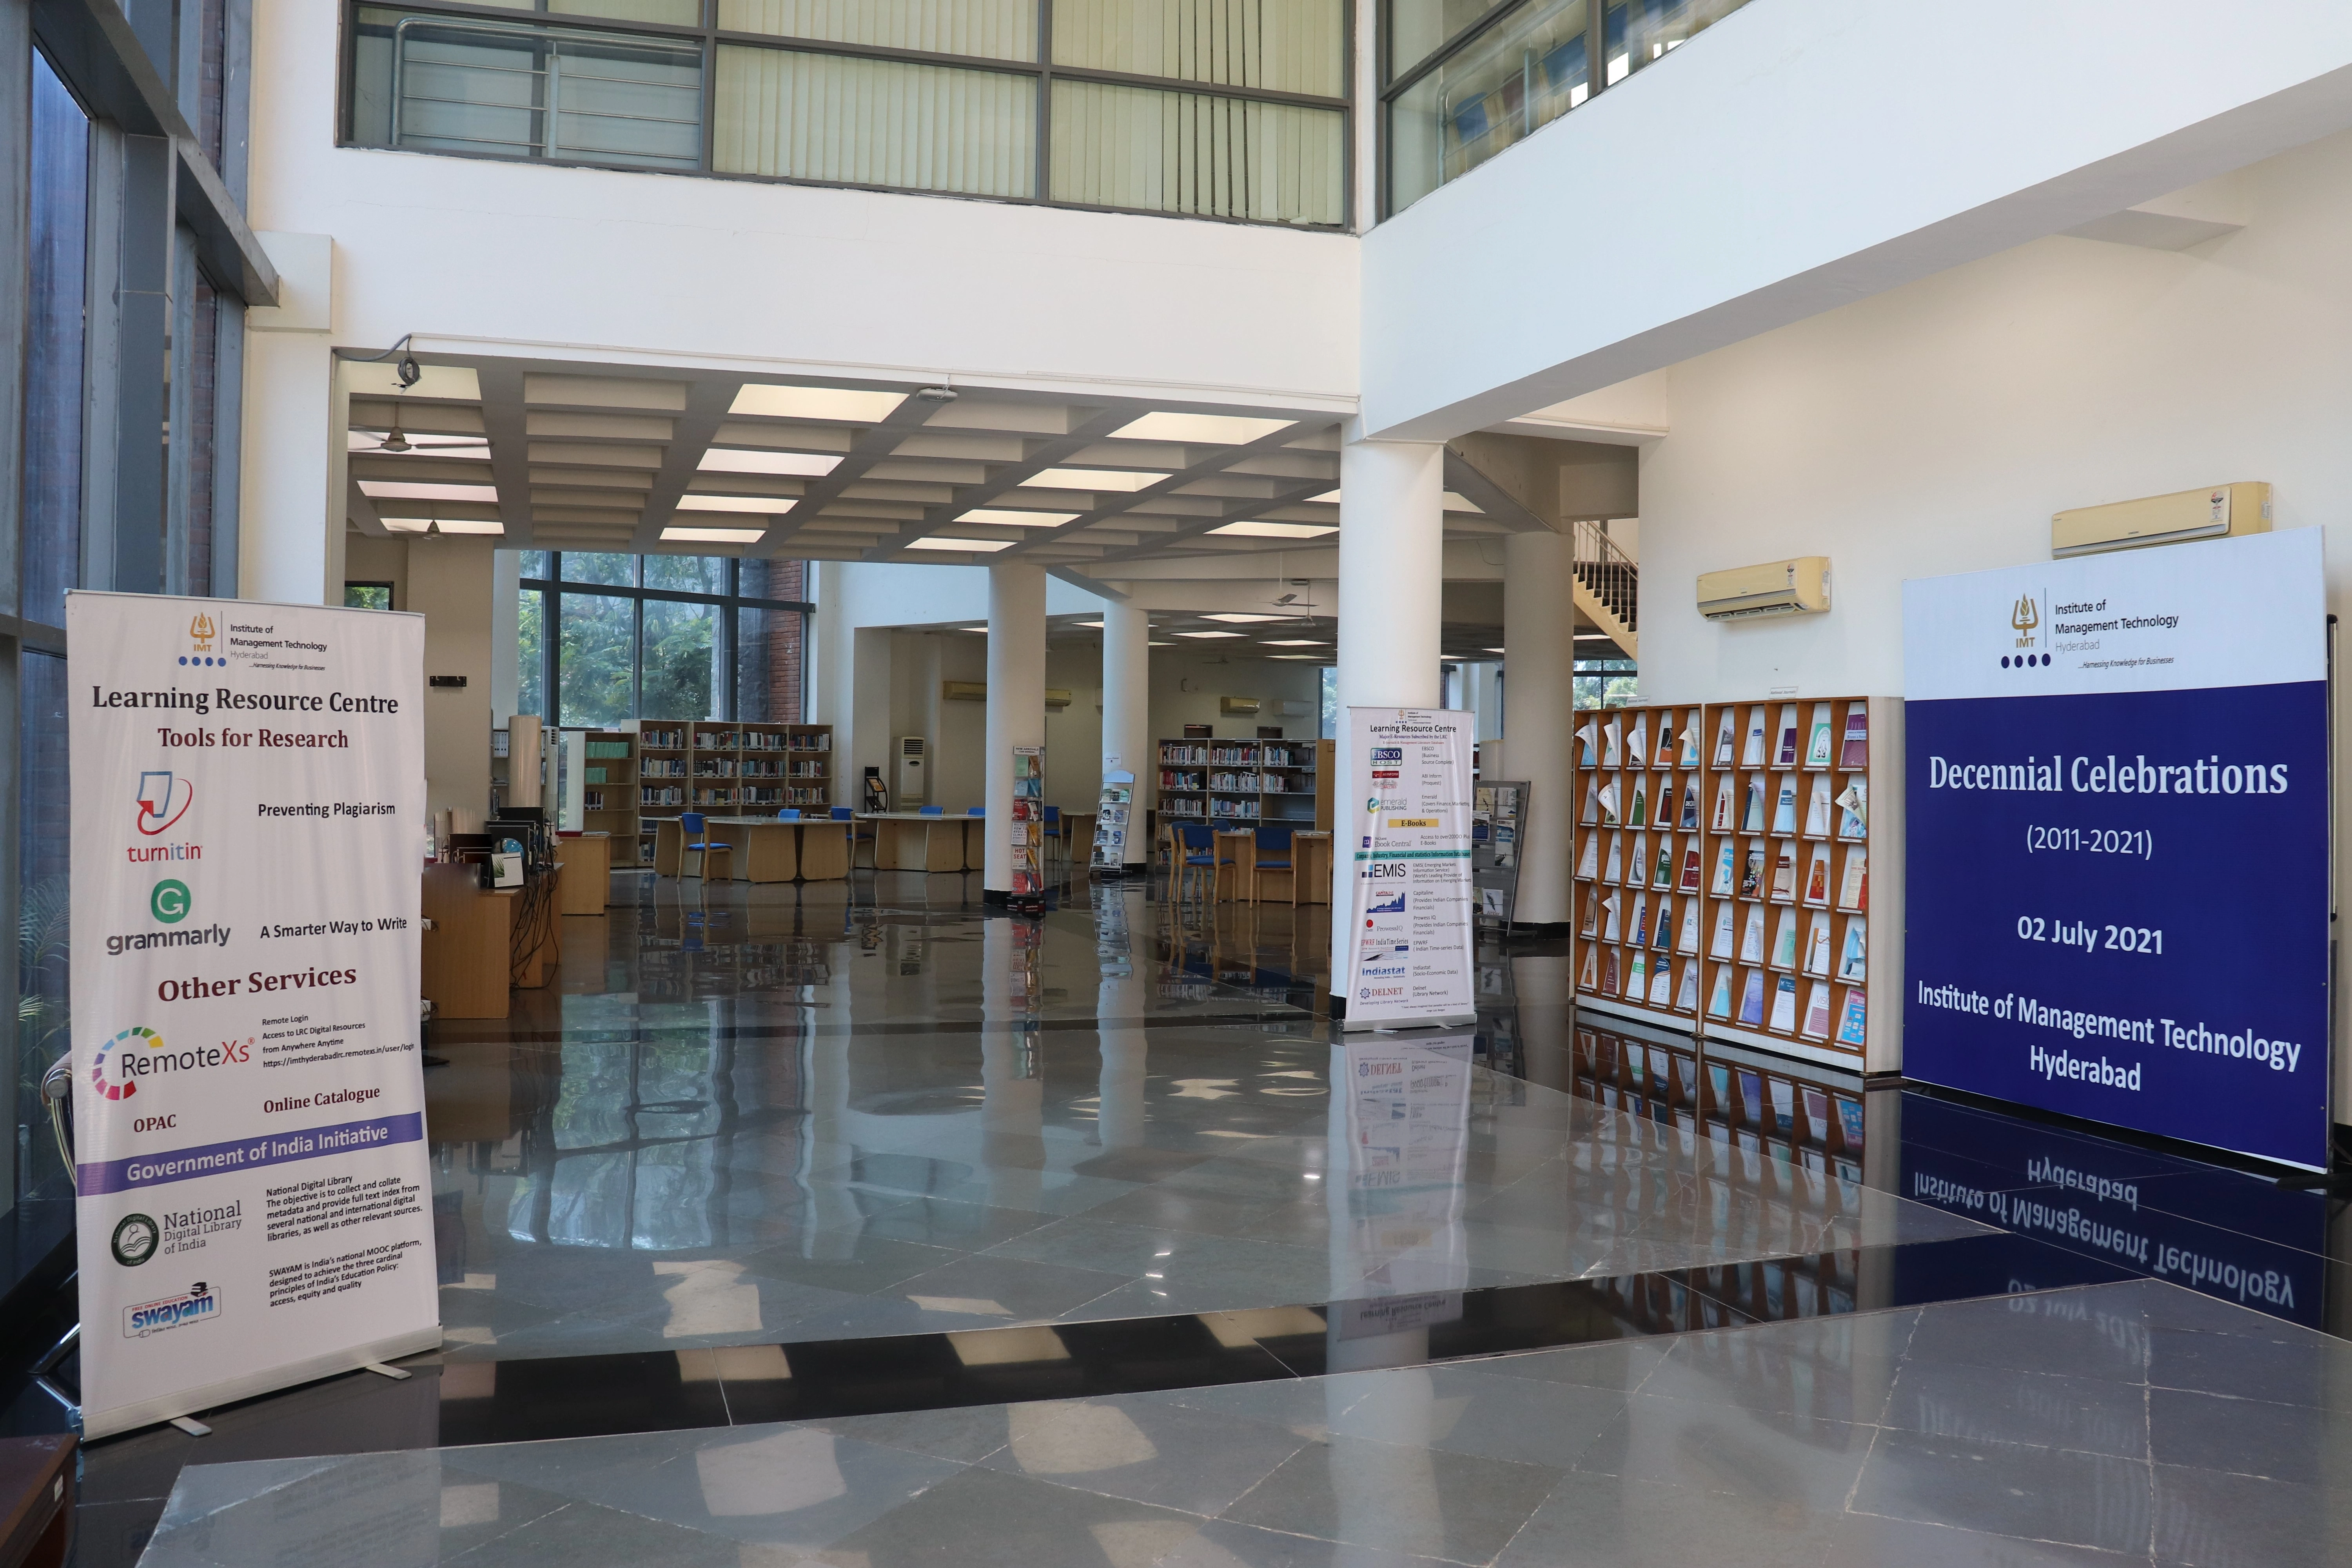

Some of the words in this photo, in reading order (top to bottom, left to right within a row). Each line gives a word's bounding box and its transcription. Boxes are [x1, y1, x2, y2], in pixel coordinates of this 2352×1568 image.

[2056, 603, 2093, 615] Institute
[2096, 599, 2106, 611] of
[230, 624, 263, 633] Institute
[265, 626, 274, 634] of
[2056, 620, 2118, 635] Management
[2121, 614, 2179, 629] Technology
[230, 637, 283, 649] Management
[284, 640, 327, 652] Technology
[2016, 637, 2035, 648] IMT
[2056, 639, 2100, 654] Hyderabad
[230, 650, 268, 660] Hyderabad
[2109, 658, 2138, 668] Knowledge
[2146, 657, 2174, 665] Businesses
[93, 686, 209, 715] Learning
[216, 688, 323, 711] Resource
[330, 692, 398, 714] Centre
[158, 728, 215, 747] Tools
[221, 728, 252, 747] for
[258, 729, 348, 748] Research
[1370, 725, 1400, 733] Learning
[1372, 750, 1400, 759] EBSCO
[1930, 755, 2063, 791] Decennial
[2071, 755, 2288, 794] Celebrations
[259, 803, 329, 818] Preventing
[334, 802, 395, 818] Plagiarism
[1380, 797, 1407, 806] emerald
[2027, 824, 2152, 860] (2011-2021)
[127, 843, 201, 862] turnitin
[1374, 863, 1406, 878] EMIS
[260, 926, 270, 939] A
[274, 924, 327, 938] Smarter
[329, 921, 359, 935] Way
[361, 920, 373, 931] to
[377, 917, 407, 930] Write
[2018, 916, 2045, 941] 02
[2051, 920, 2098, 953] July
[2105, 925, 2162, 955] 2021
[107, 923, 231, 956] grammarly
[1362, 967, 1405, 976] Indiastat
[158, 977, 241, 1002] Other
[249, 967, 356, 993] Services
[1372, 987, 1403, 996] DELNET
[262, 1017, 289, 1025] Remote
[290, 1014, 309, 1023] Login
[310, 1025, 331, 1035] Digital
[332, 1023, 365, 1031] Resources
[1919, 980, 1989, 1015] Institute
[1994, 993, 2014, 1019] of
[2018, 996, 2154, 1044] Management
[2160, 1018, 2301, 1072] Technology
[281, 1042, 316, 1052] Anywhere
[317, 1038, 344, 1047] Anytime
[2031, 1045, 2140, 1091] Hyderabad
[264, 1097, 310, 1113] Online
[314, 1088, 380, 1106] Catalogue
[134, 1114, 176, 1132] OPAC
[127, 1148, 244, 1181] Government
[249, 1142, 267, 1161] of
[272, 1136, 313, 1157] India
[319, 1125, 388, 1149] Initiative
[266, 1199, 281, 1208] The
[283, 1192, 318, 1205] objective
[319, 1190, 326, 1198] is
[337, 1184, 361, 1195] collect
[363, 1180, 376, 1190] and
[379, 1177, 401, 1187] collate
[267, 1183, 299, 1197] National
[301, 1179, 325, 1191] Digital
[327, 1176, 352, 1186] Library
[163, 1200, 241, 1230] National
[267, 1217, 294, 1230] several
[297, 1210, 327, 1225] national
[330, 1208, 343, 1218] and
[345, 1198, 392, 1215] international
[393, 1194, 415, 1206] digital
[164, 1225, 200, 1241] Digital
[203, 1219, 242, 1234] Library
[164, 1243, 175, 1254] of
[178, 1239, 206, 1252] India
[269, 1263, 302, 1278] SWAYAM
[312, 1257, 335, 1268] India's
[336, 1250, 365, 1263] national
[367, 1245, 389, 1256] MOOC
[391, 1240, 422, 1251] platform,
[270, 1284, 305, 1299] principles
[307, 1280, 315, 1289] of
[316, 1275, 339, 1287] India's
[341, 1269, 375, 1281] Education
[270, 1296, 296, 1307] access,
[298, 1290, 321, 1301] equity
[322, 1285, 336, 1295] and
[338, 1281, 362, 1292] quality
[162, 1296, 188, 1305] EDUCATION
[132, 1296, 213, 1328] swayam
